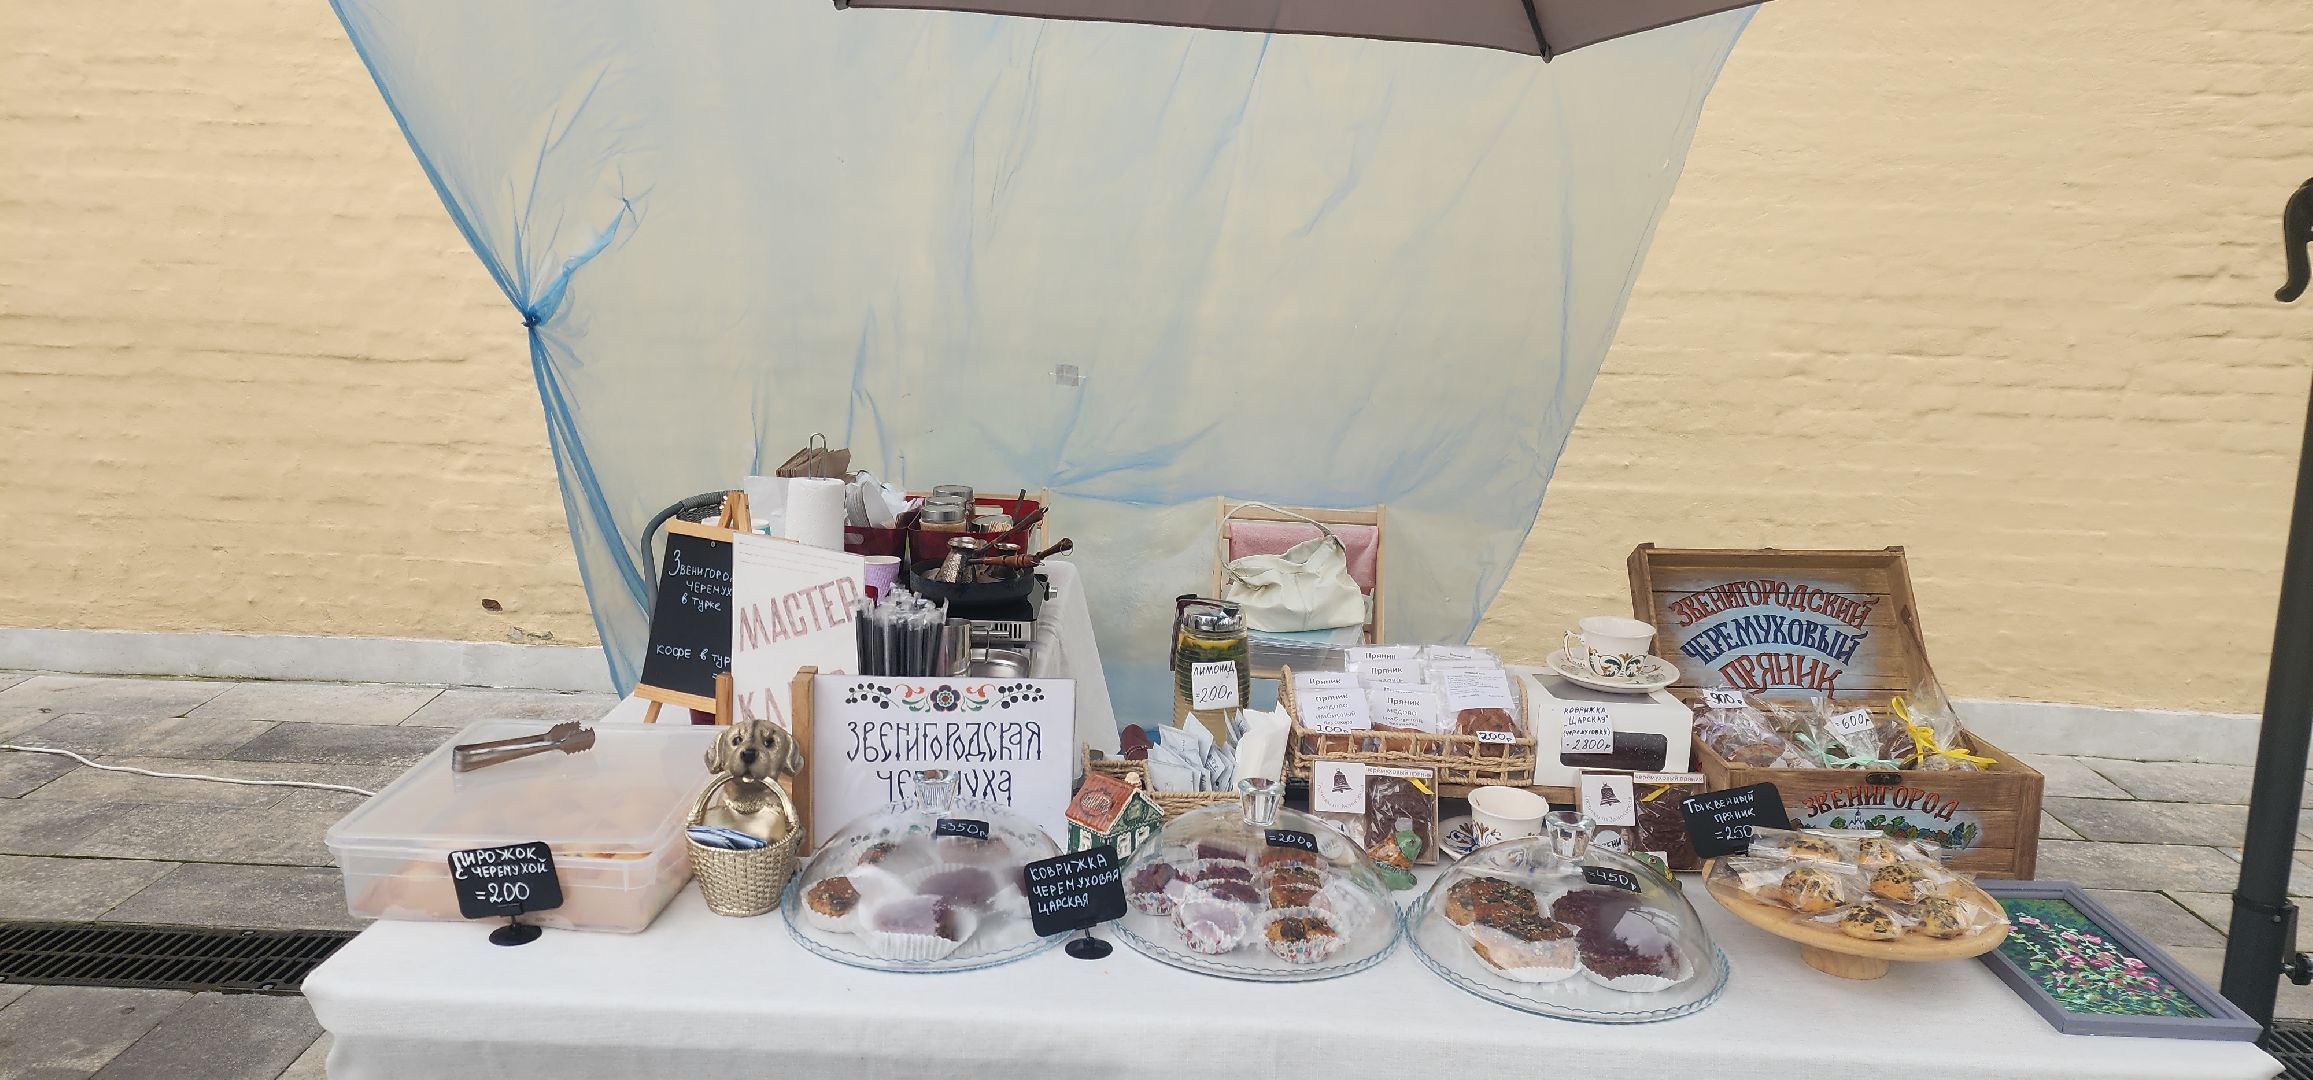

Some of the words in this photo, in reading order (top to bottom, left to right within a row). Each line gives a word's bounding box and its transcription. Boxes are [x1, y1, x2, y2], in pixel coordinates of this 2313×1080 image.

[686, 580, 732, 597] ЧЕРЕМУХ
[739, 576, 860, 652] МАСТЕР
[1668, 579, 1880, 630] ЗВЕНИГОРОДСКИЙ
[656, 645, 691, 660] КОФЕ
[1679, 614, 1869, 666] ЧЕРЕМУХОВЫЙ
[1193, 661, 1235, 677] ЛИМОНАД
[1718, 652, 1843, 700] ПРЯНИК
[1387, 697, 1420, 706] Пряник
[847, 721, 1041, 762] ЗВЕНИГОРОДСКАЯ
[876, 769, 1013, 808] ЧЕУХА
[1801, 784, 1961, 823] ЗВЕНИГОРОД
[1714, 824, 1755, 841] =250
[451, 847, 538, 870] ПИРОЖОК
[470, 857, 549, 879] ЧЕРЕМУХОЙ
[1030, 853, 1108, 882] КОВРИЖКА
[474, 881, 531, 904] =200
[1032, 867, 1120, 898] ЧЕРЕМУХОВАЯ
[1037, 891, 1090, 916] ЦАРСКАЯ
